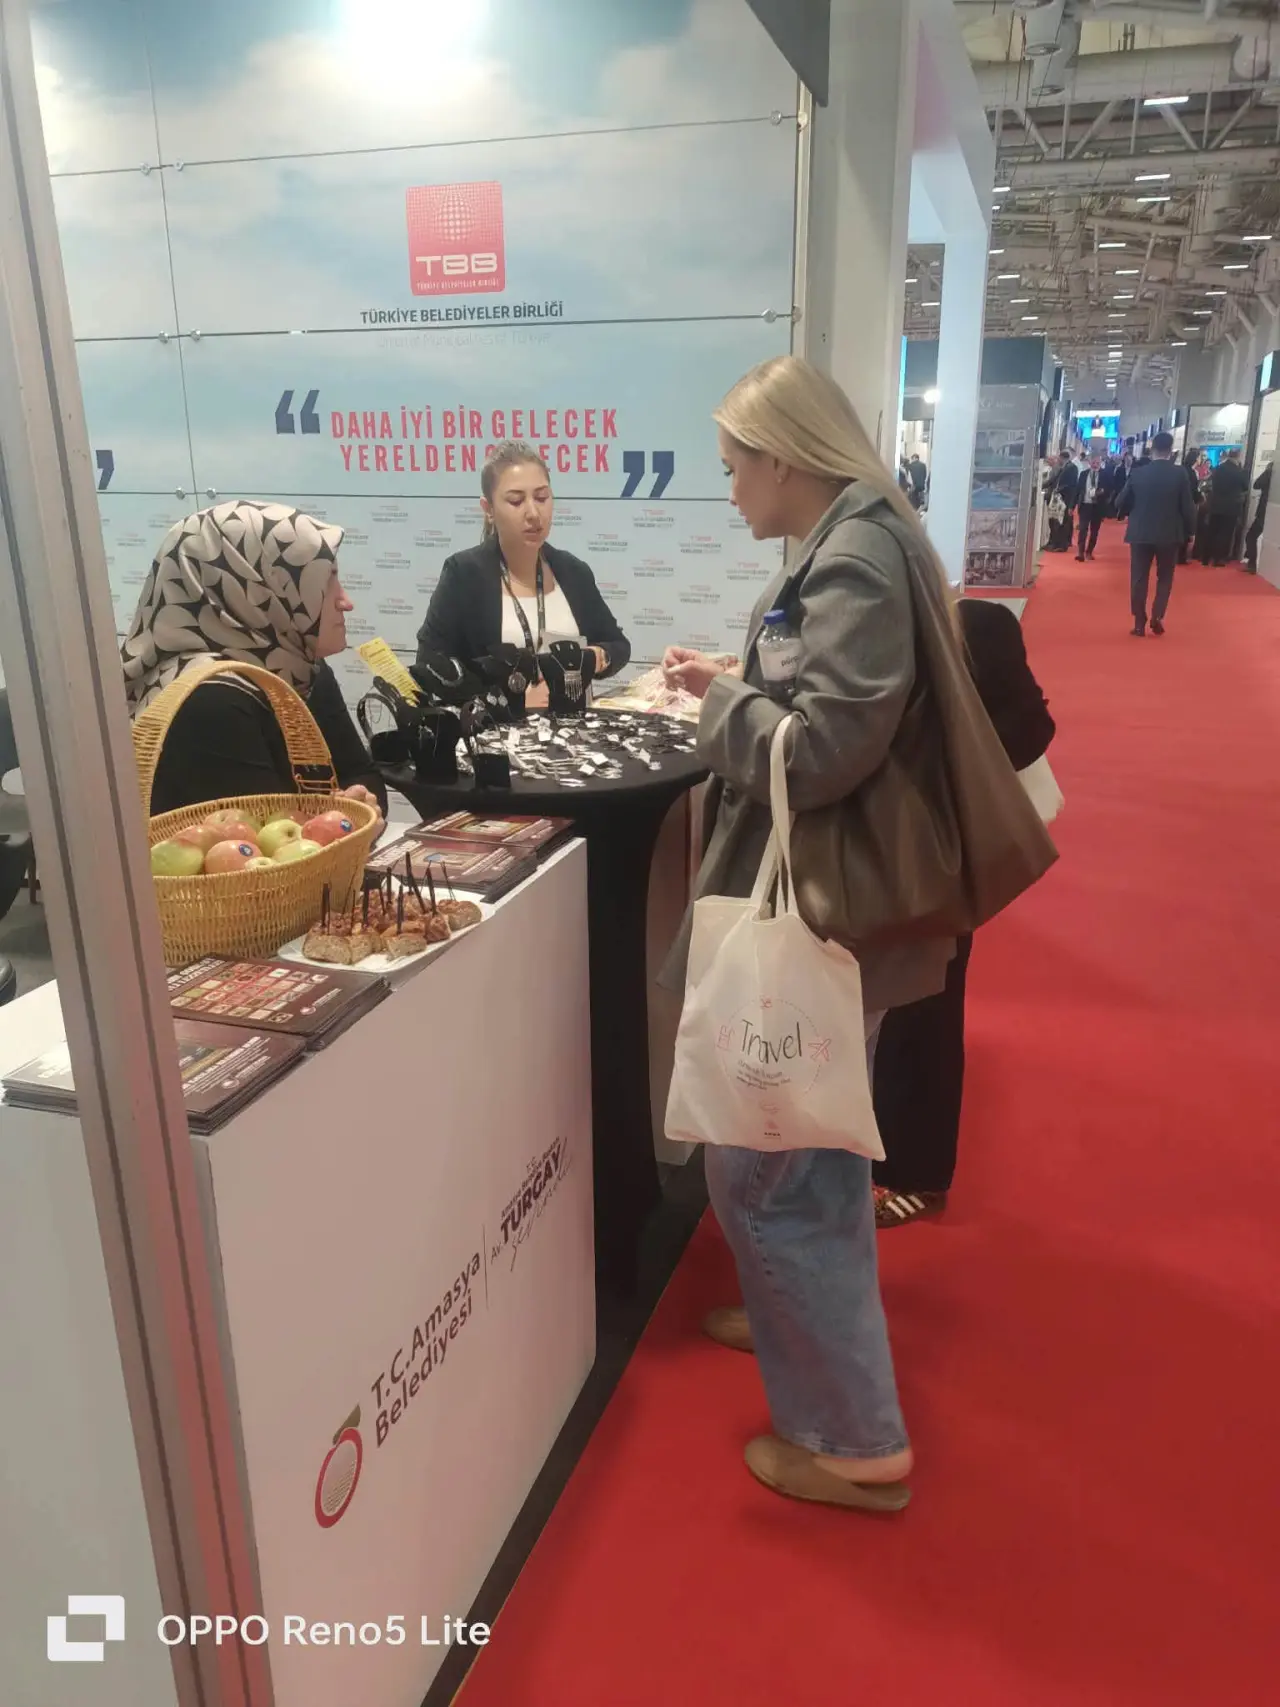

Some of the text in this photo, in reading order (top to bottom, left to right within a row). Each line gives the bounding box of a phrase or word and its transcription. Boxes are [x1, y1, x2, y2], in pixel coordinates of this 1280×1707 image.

[416, 252, 498, 276] TBB
[360, 300, 563, 325] TÜRKİYE BELEDİYELER BİRLİĞİ
[331, 404, 619, 439] DAHA İYİ BİR GELECEK
[340, 444, 476, 472] YERELDEN
[740, 1018, 803, 1064] Travel
[501, 1143, 561, 1245] TURGAY
[375, 1288, 472, 1448] Belediyesi
